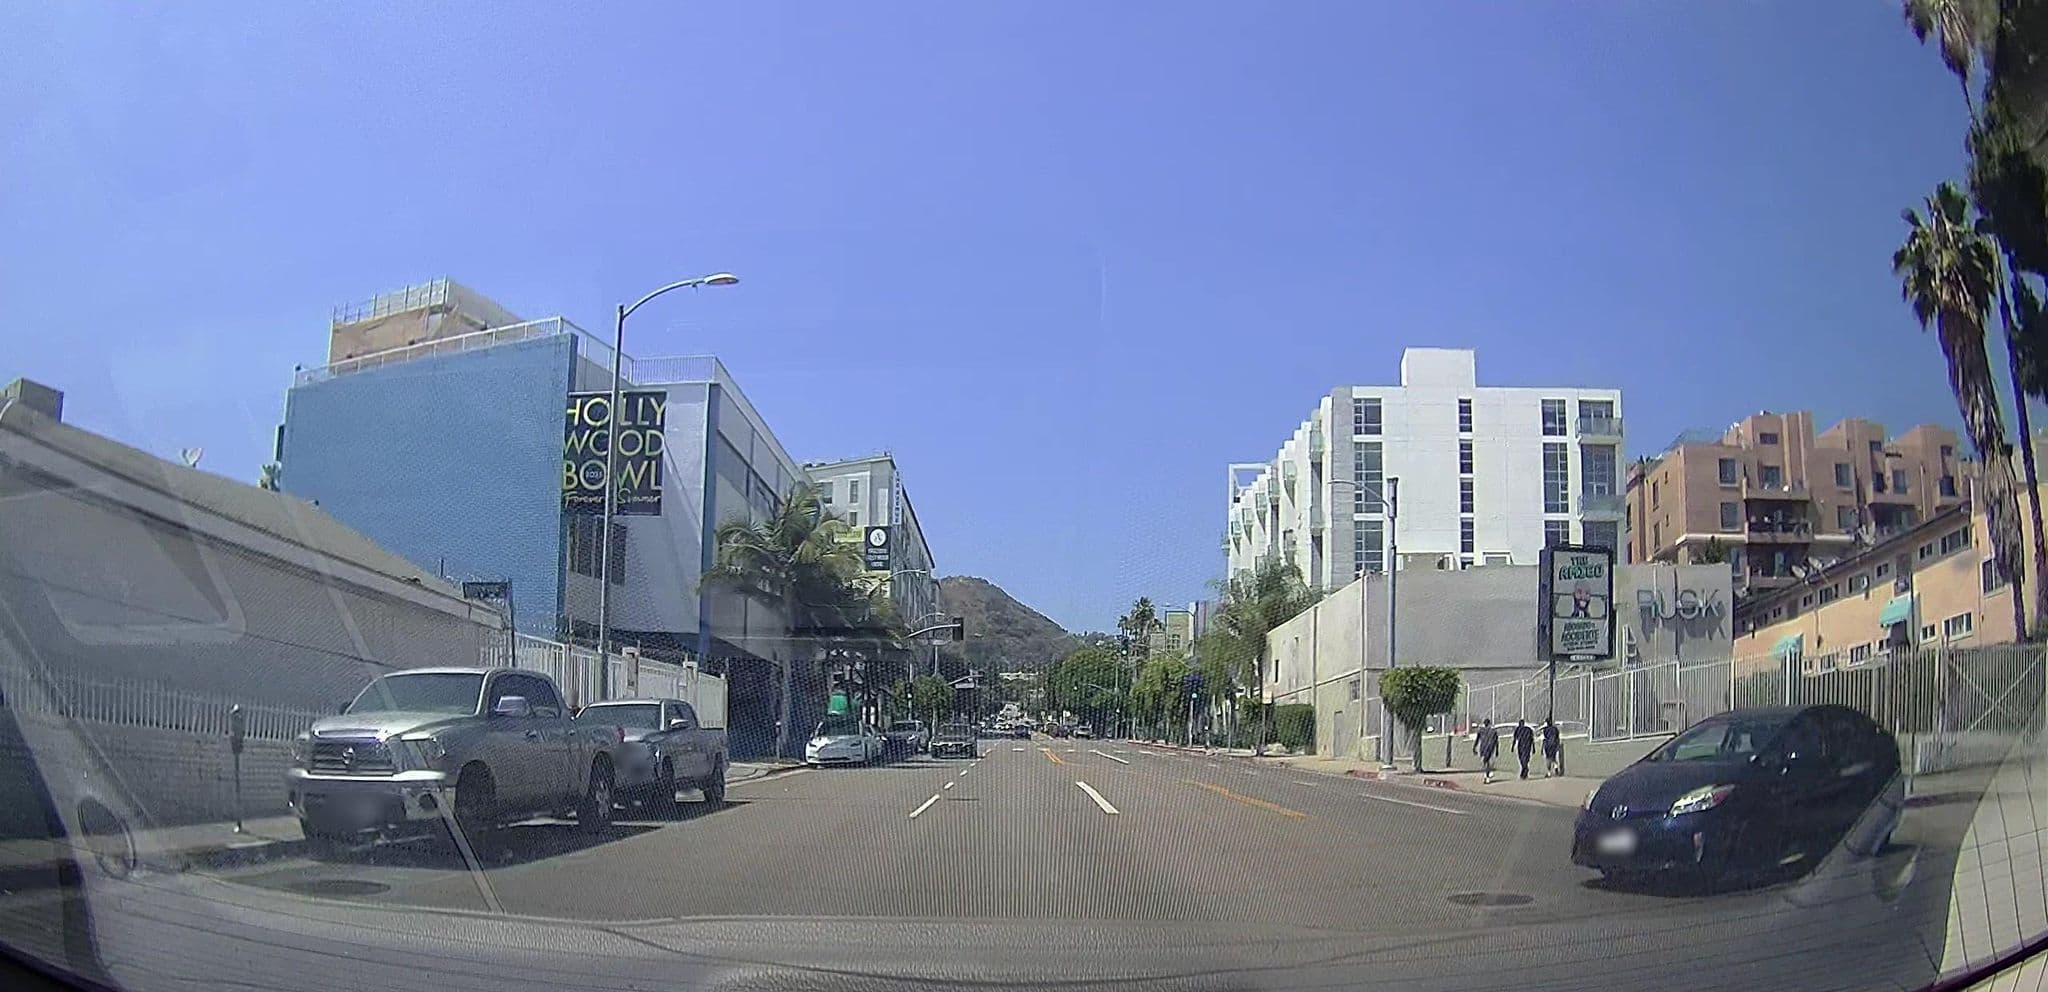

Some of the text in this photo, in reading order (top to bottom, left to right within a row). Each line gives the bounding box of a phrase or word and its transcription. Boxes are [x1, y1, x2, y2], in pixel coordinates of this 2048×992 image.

[563, 429, 665, 456] WOOD
[563, 460, 662, 490] BOWL
[1637, 587, 1720, 619] RUSK
